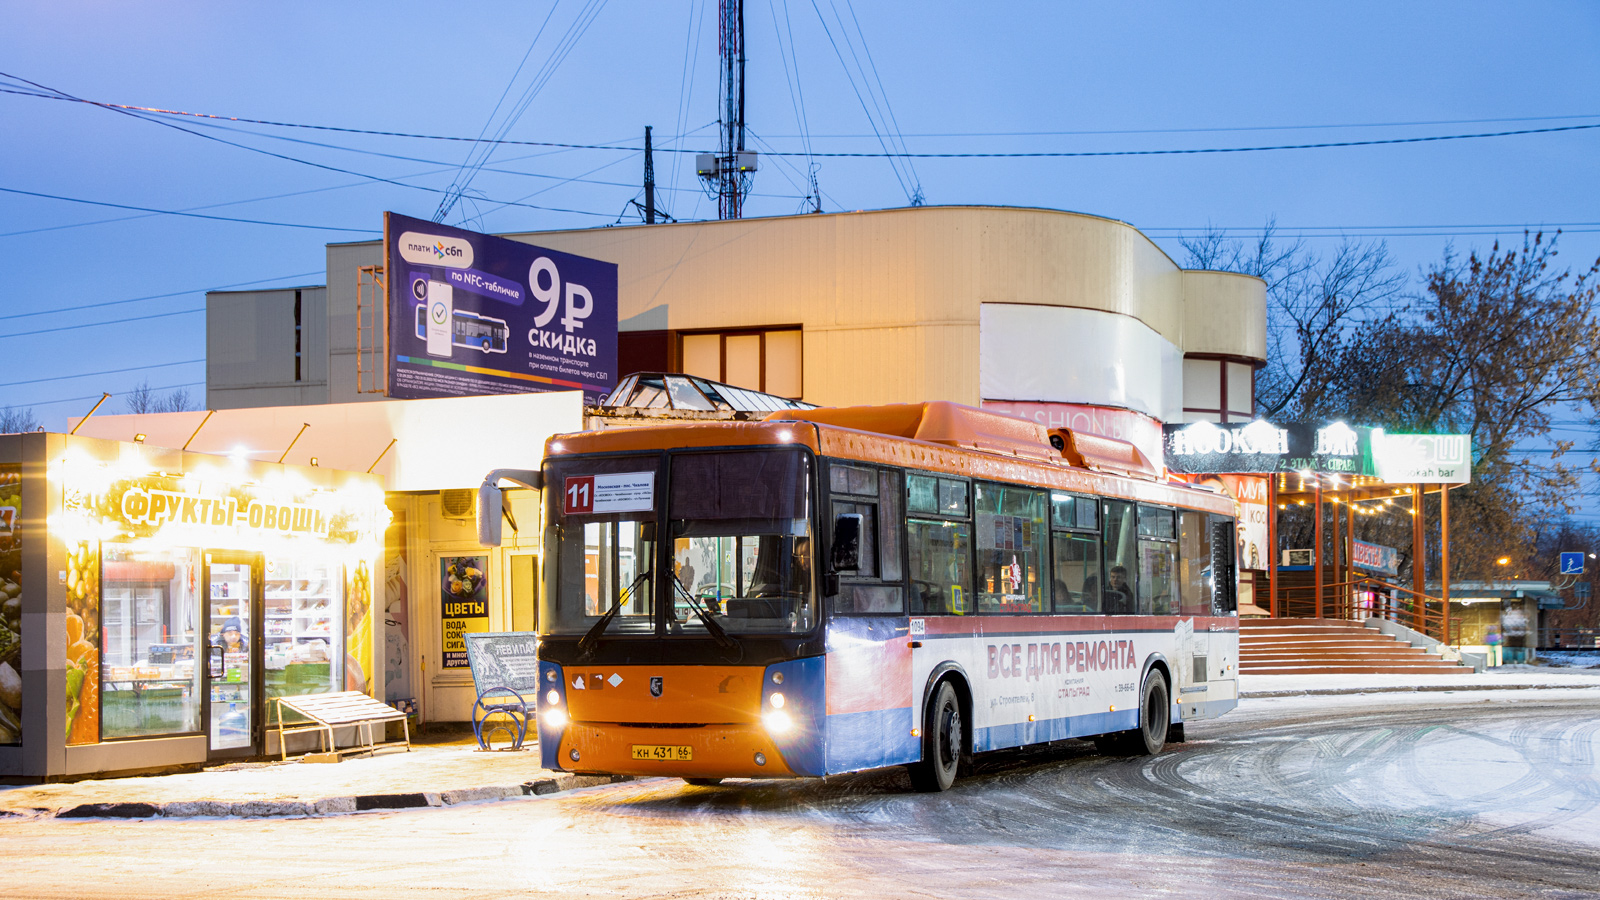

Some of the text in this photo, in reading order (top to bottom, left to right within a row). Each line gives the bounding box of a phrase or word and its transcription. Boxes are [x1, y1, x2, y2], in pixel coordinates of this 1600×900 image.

[408, 243, 463, 257] плати сбп
[451, 271, 520, 299] по NFC-табличке
[528, 328, 596, 357] скидка
[533, 353, 559, 362] наземном
[560, 357, 589, 368] транспорте
[528, 361, 608, 380] при оплате билетов через СБП
[999, 409, 1106, 437] SHION
[1173, 428, 1289, 455] HOKH
[1280, 459, 1287, 469] 2
[1290, 458, 1318, 470] ЭТАЖ
[1328, 458, 1356, 471] СПРАВА
[1438, 467, 1455, 478] bar
[567, 482, 589, 508] 11
[445, 602, 485, 616] ЦВЕТЫ
[446, 621, 467, 630] ВОДА
[911, 621, 924, 632] 1094
[446, 641, 465, 649] СИГА
[446, 659, 468, 667] другое
[987, 639, 1137, 682] ВСЕ ДЛЯ РЕМОНТА
[1058, 686, 1090, 698] СТАЛЬГРАД
[637, 747, 688, 758] КН 431 66
